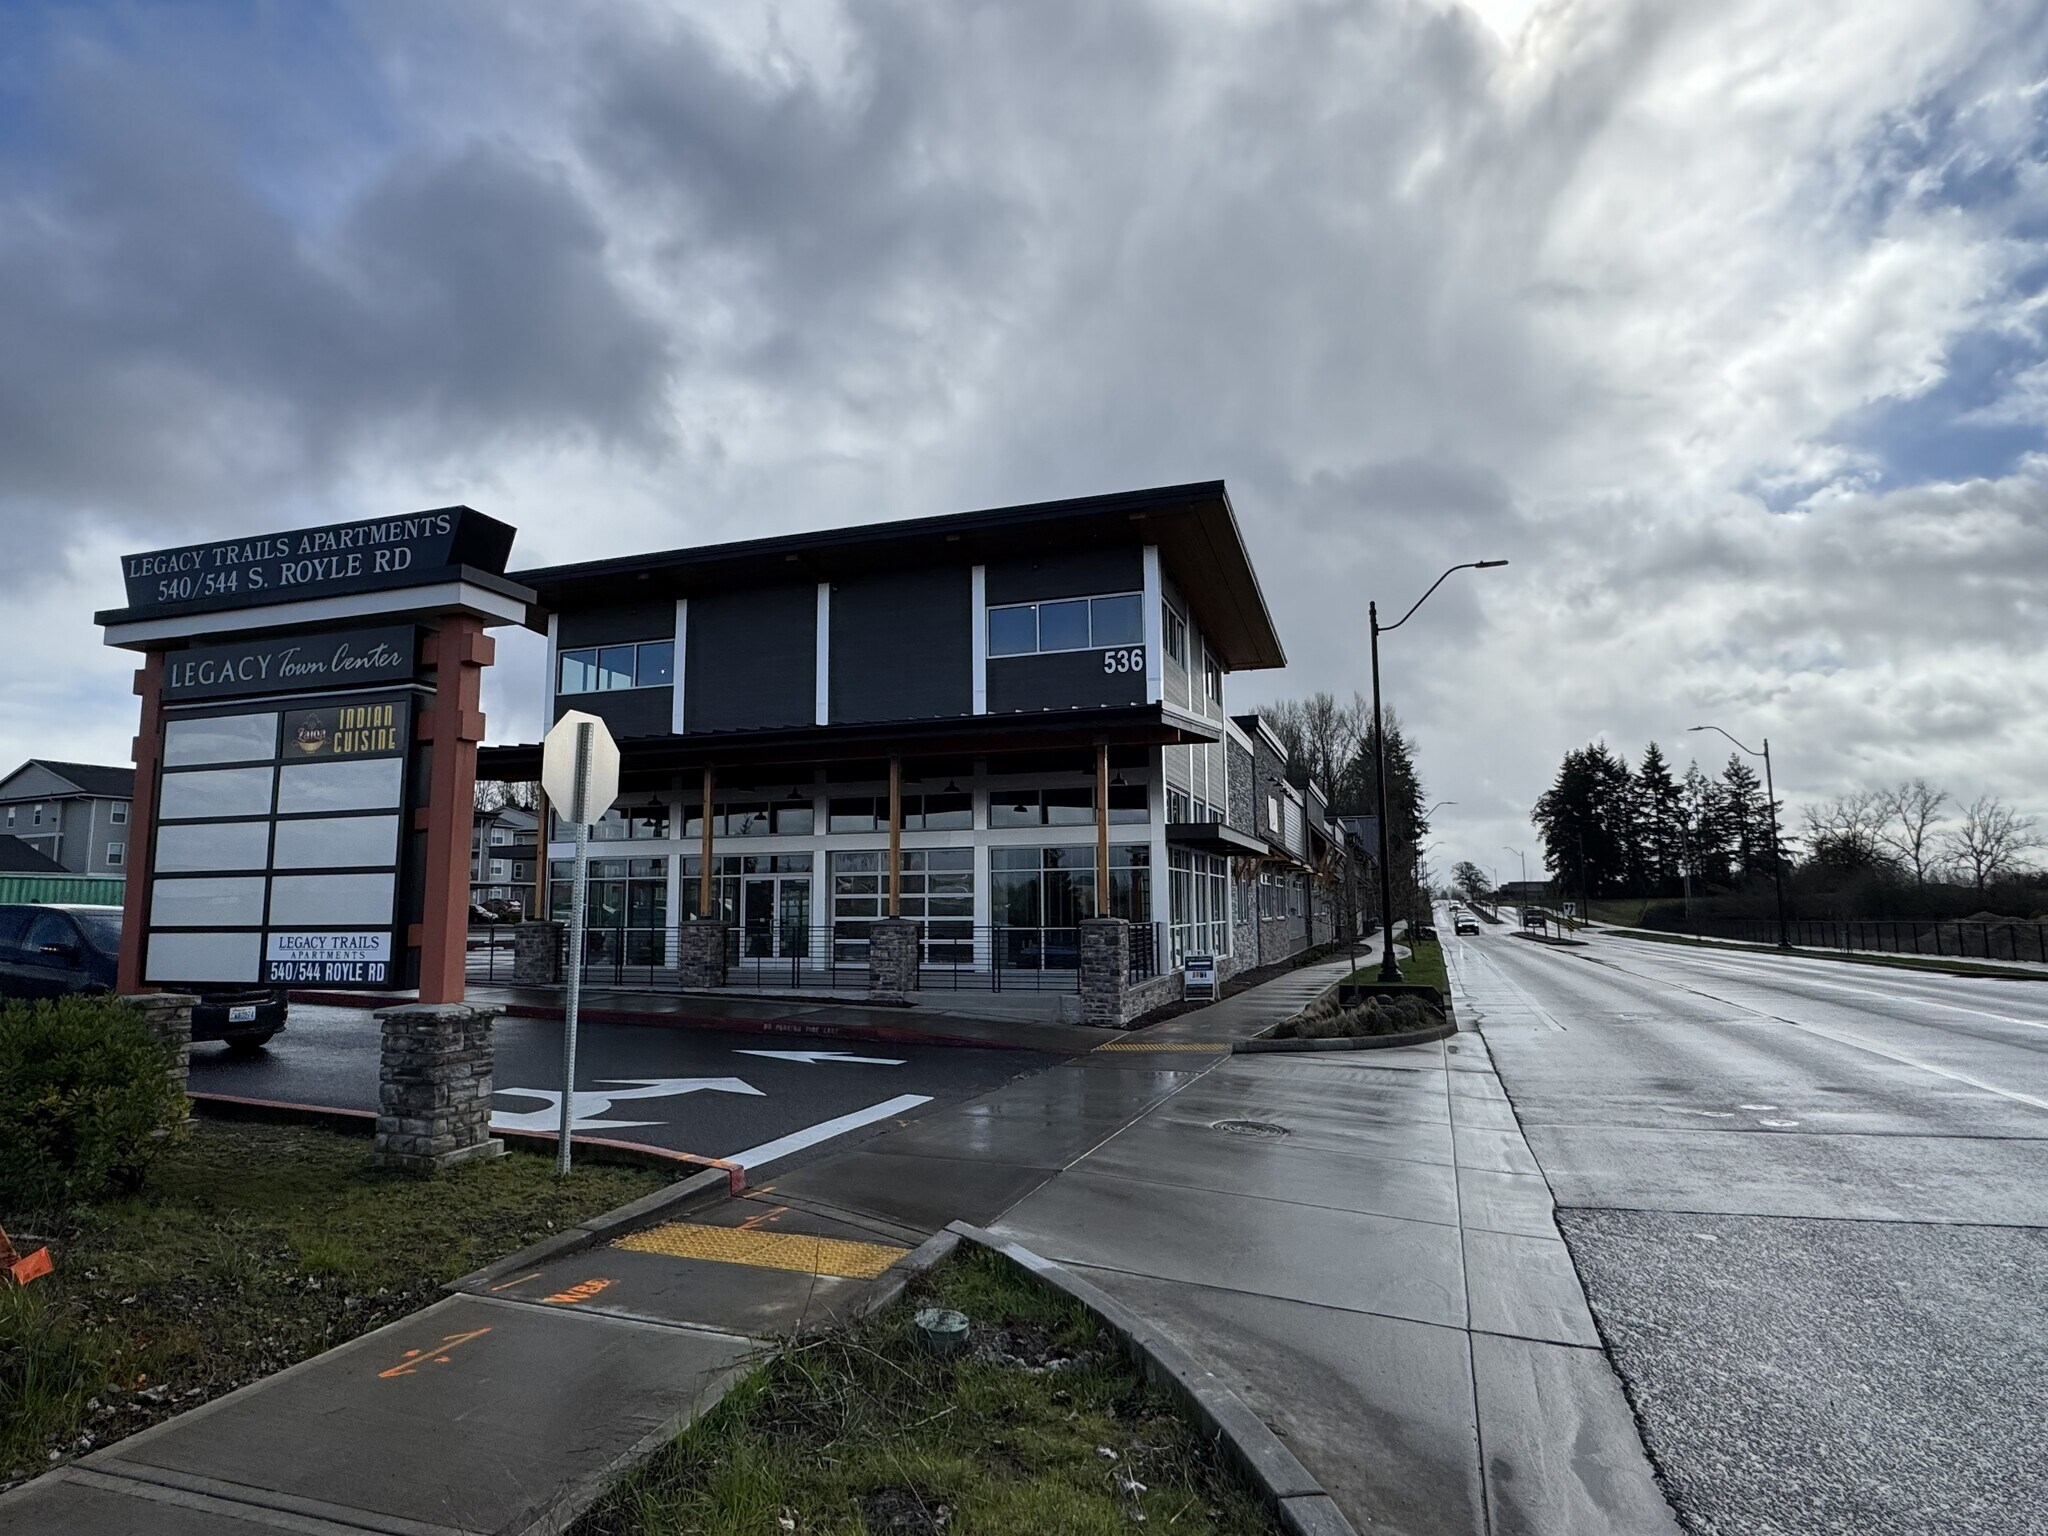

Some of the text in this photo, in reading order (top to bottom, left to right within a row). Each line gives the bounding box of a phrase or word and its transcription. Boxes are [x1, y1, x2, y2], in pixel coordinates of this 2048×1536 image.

[129, 514, 451, 578] LEGACY TRAILS APARTMENTS
[158, 547, 412, 601] 540/544 S. ROYLE RD
[171, 643, 403, 688] LEGACY Town Center
[1103, 648, 1144, 674] 536
[339, 705, 393, 730] INDIAN
[333, 727, 397, 753] CUISINE
[279, 936, 380, 949] LEGACY TRAILS
[290, 951, 366, 960] APARTMENTS
[270, 962, 385, 981] 540/544 ROYLE RD
